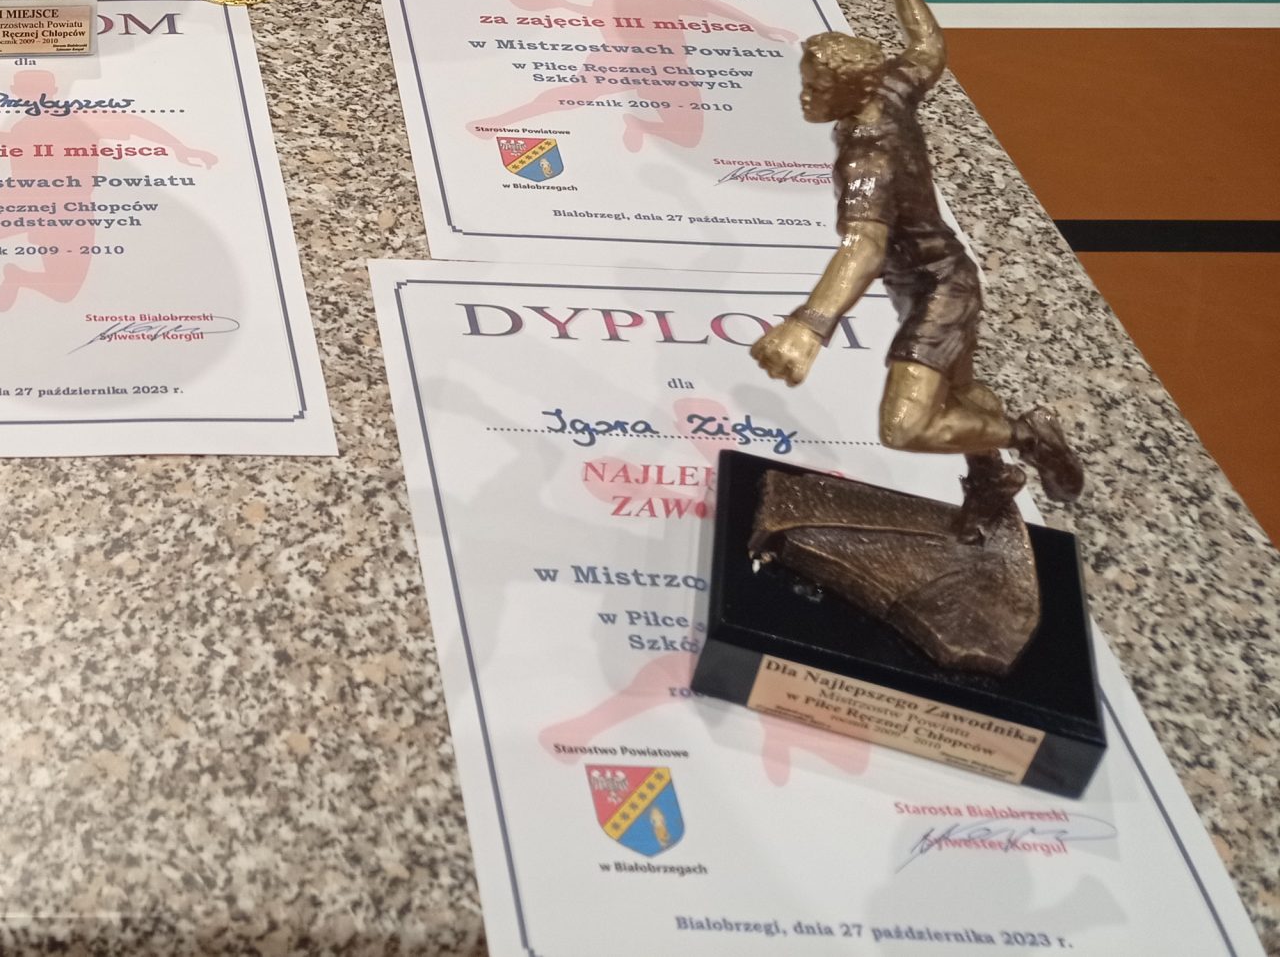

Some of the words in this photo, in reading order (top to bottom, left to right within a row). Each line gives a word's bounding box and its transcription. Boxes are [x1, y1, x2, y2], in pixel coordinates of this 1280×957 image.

[7, 9, 58, 18] MIEJSCE
[480, 16, 508, 24] za
[517, 15, 604, 28] zajęcie
[613, 17, 645, 28] III
[653, 20, 754, 33] miejsca
[2, 30, 38, 39] Ręcznej
[495, 40, 674, 54] Mistrzostwach
[682, 46, 783, 57] Powiatu
[532, 62, 577, 71] Piłce
[583, 64, 657, 75] Ręcznej
[663, 66, 753, 78] Chłopców
[533, 74, 587, 83] Szkół
[594, 76, 742, 90] Podstawowych
[628, 100, 670, 108] 2009
[690, 103, 732, 111] 2010
[33, 145, 54, 157] II
[64, 144, 168, 160] miejsca
[92, 175, 195, 187] Powiatu
[513, 183, 577, 191] Białobrzegach
[64, 201, 158, 214] Chłopców
[552, 210, 630, 220] Białobrzegi,
[688, 216, 773, 225] października
[15, 246, 58, 255] 2009
[80, 246, 124, 254] 2010
[139, 313, 213, 322] Białobrzeski
[668, 378, 694, 389] dla
[15, 388, 32, 396] 27
[38, 386, 128, 398] października
[133, 386, 168, 394] 2023
[534, 569, 558, 582] w
[598, 613, 617, 624] w
[625, 611, 688, 627] Piłce
[766, 660, 797, 678] Dla
[803, 669, 918, 711] Najlepszego
[924, 704, 1037, 744] Zawodnika
[554, 744, 617, 755] Starostwo
[620, 746, 688, 757] Powiatowe
[894, 802, 963, 816] Starosta
[614, 862, 707, 876] Białobrzegach
[676, 917, 787, 936] Białobrzegi,
[793, 921, 834, 935] dnia
[840, 923, 862, 937] 27
[871, 926, 995, 944] października
[1001, 931, 1051, 947] 2023
[1057, 937, 1073, 948] r.
